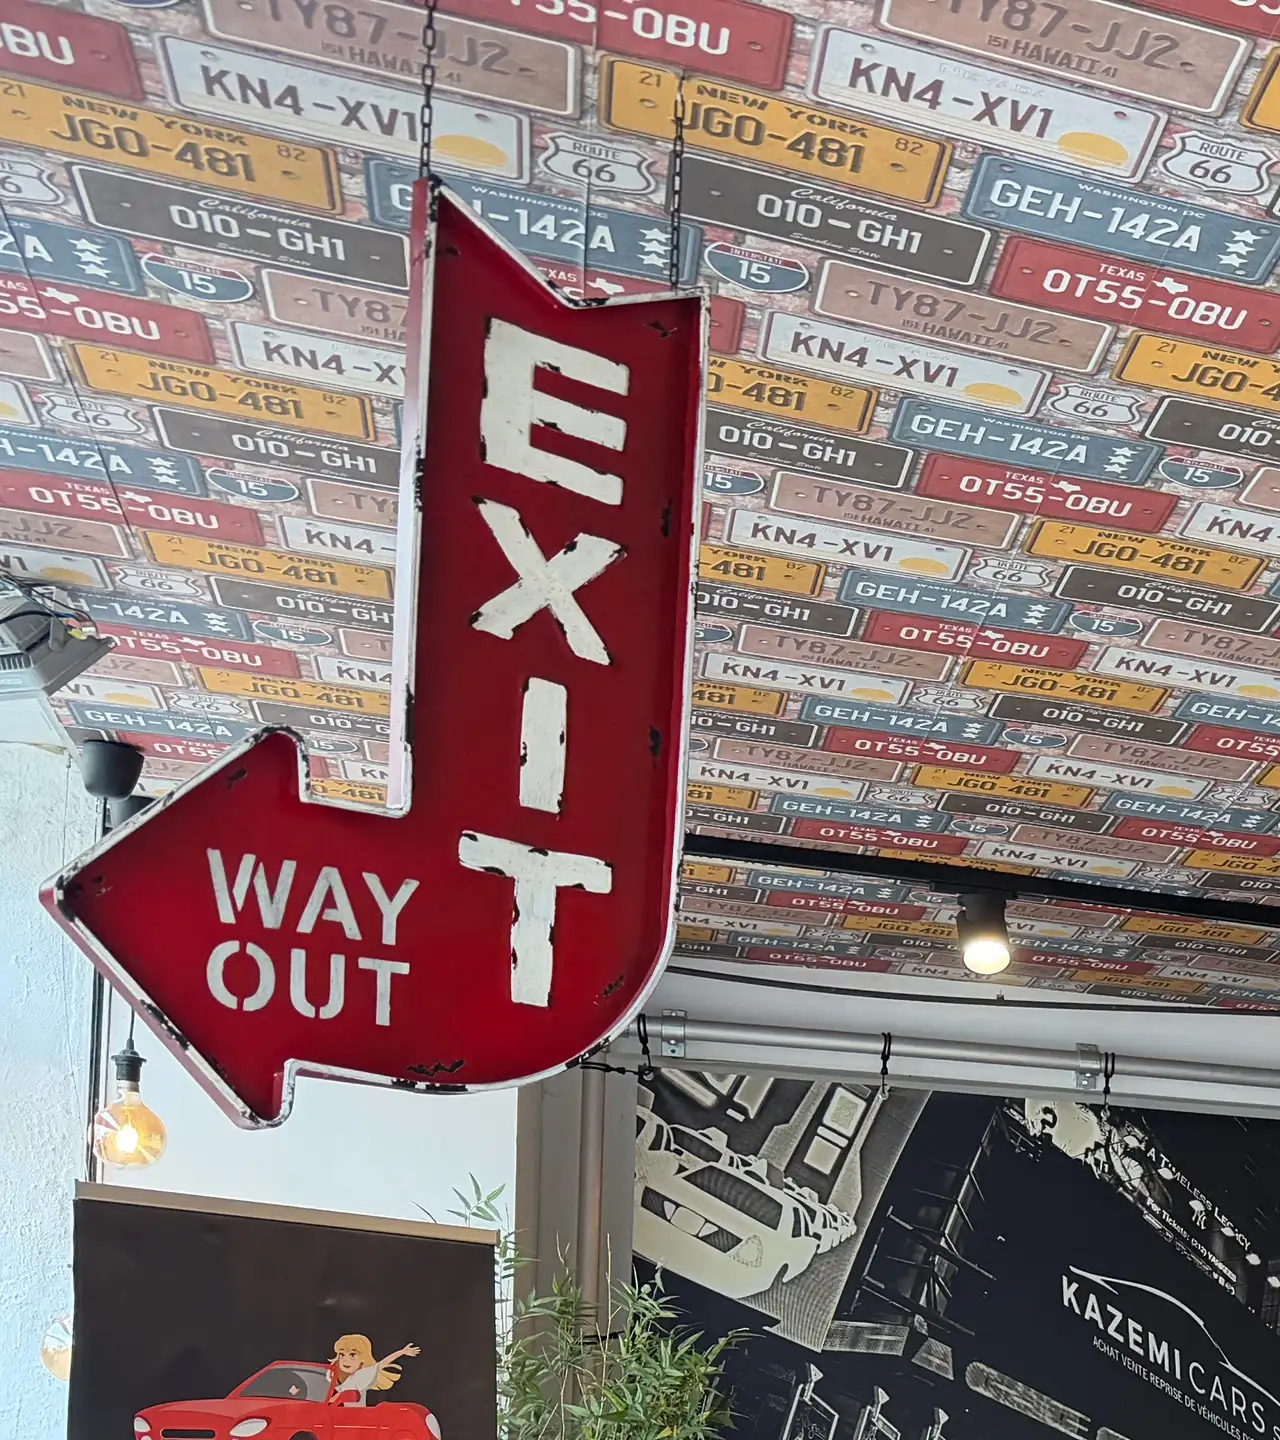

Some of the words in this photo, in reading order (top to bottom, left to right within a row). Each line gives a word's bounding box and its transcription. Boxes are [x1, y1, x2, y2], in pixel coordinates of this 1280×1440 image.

[1196, 140, 1255, 162] ROUTE
[569, 160, 617, 182] 66
[1183, 161, 1233, 183] 66
[786, 190, 899, 219] California
[992, 181, 1200, 251] GEH-142A
[739, 260, 777, 283] 15
[1101, 264, 1148, 282] TEXAS
[868, 283, 1059, 343] TY87-JJ2
[923, 323, 997, 347] HAWAII
[912, 415, 1086, 464] GEH-142A
[458, 317, 630, 1008] EXIT
[206, 848, 420, 946] WAY
[206, 939, 410, 1027] OUT
[1092, 1336, 1121, 1362] ACHAT
[1121, 1353, 1149, 1382] VENTE
[1150, 1372, 1183, 1404] REPRISE
[1184, 1396, 1196, 1412] DE
[1196, 1403, 1242, 1440] VÉHICULES
